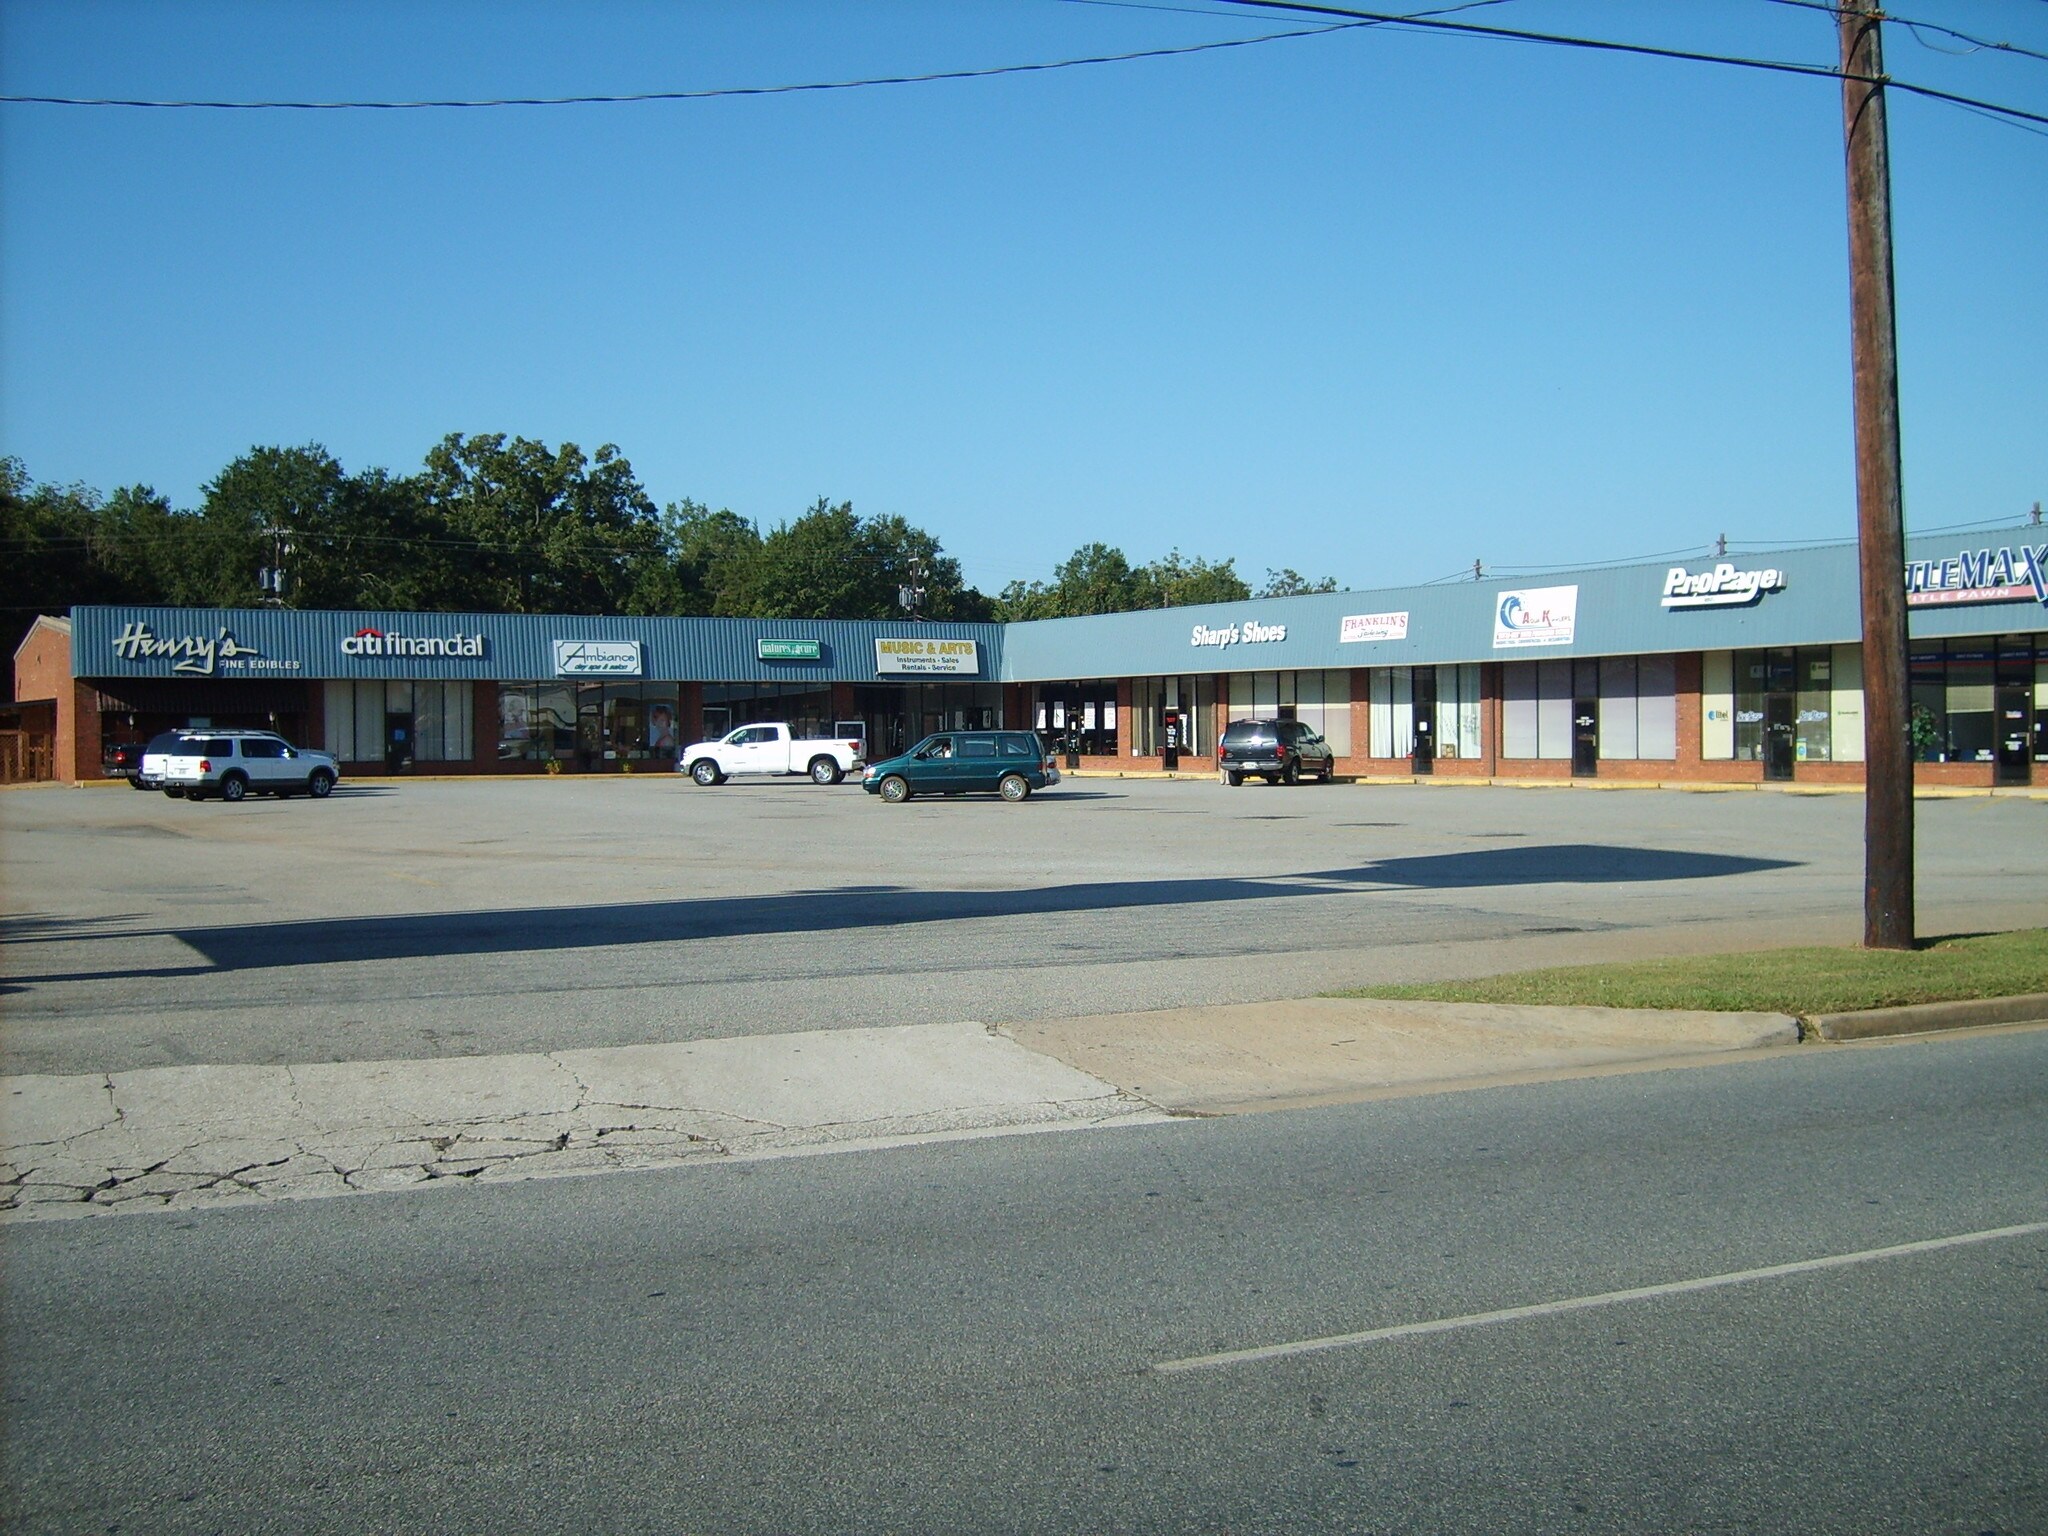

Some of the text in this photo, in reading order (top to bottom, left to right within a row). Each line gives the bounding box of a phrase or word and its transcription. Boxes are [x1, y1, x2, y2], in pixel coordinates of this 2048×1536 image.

[1905, 544, 2048, 603] TLEMAX
[1912, 588, 2009, 604] ITLE PAWN
[1344, 614, 1406, 632] FRANKLIN'S
[384, 631, 483, 656] financial
[1190, 620, 1286, 650] Sharp's Shoes
[112, 621, 258, 675] Henry's
[562, 643, 635, 667] Ambiance
[880, 641, 974, 656] MUSIC & ARTS
[219, 659, 300, 670] FINE EDIBLES
[896, 656, 936, 664] Instruments
[901, 663, 927, 671] Rentals
